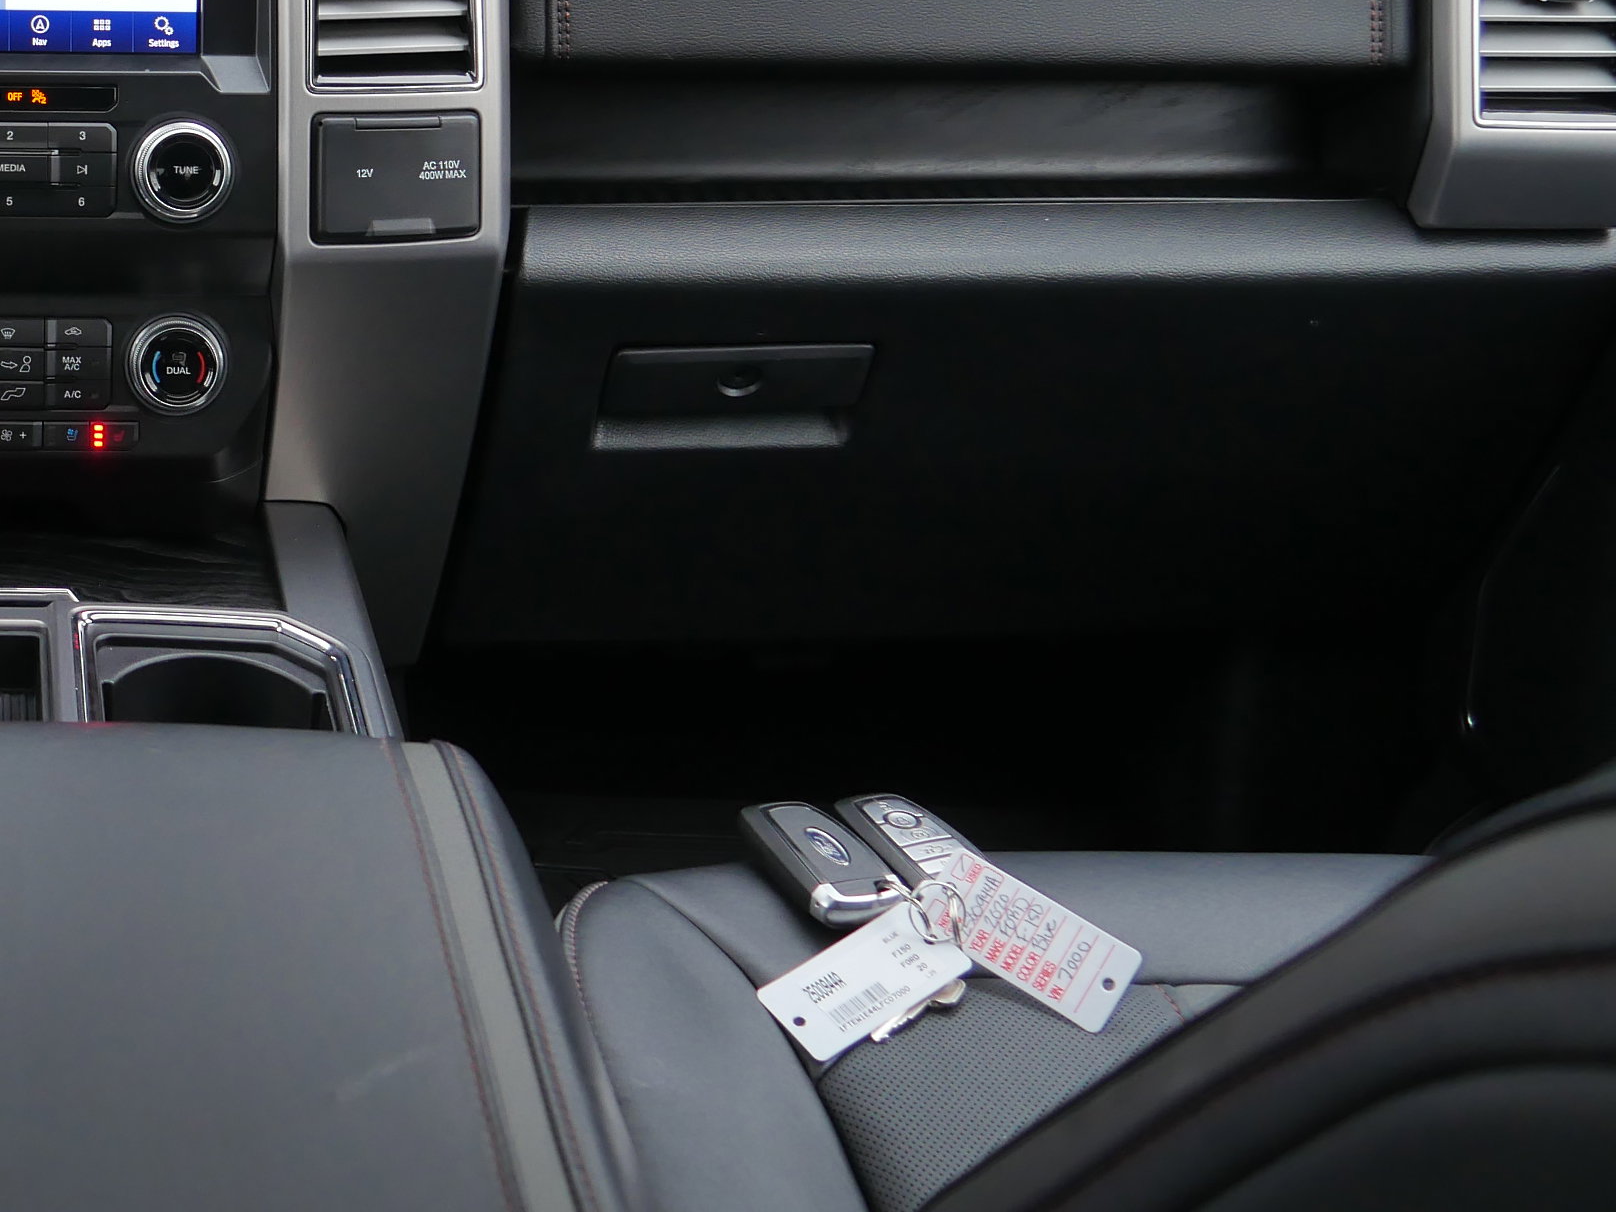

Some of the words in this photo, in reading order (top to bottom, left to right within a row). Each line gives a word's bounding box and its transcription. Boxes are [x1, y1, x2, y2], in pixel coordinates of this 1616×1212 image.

[32, 37, 48, 47] Nav
[92, 38, 112, 48] Apps
[148, 38, 180, 49] Settings
[7, 92, 23, 102] OFF
[6, 131, 14, 141] 2
[79, 131, 87, 141] 3
[423, 161, 437, 170] AC
[439, 160, 461, 170] 110V
[173, 165, 199, 176] TUNE
[356, 168, 374, 178] 12V
[419, 171, 444, 181] 400W
[445, 169, 467, 179] MAX
[6, 197, 13, 206] 5
[78, 197, 85, 207] 6
[62, 356, 82, 364] MAX
[166, 366, 192, 375] DUAL
[64, 390, 82, 399] A/C
[965, 863, 982, 884] USED
[999, 898, 1030, 937] FORD
[969, 929, 991, 953] YEAR
[986, 938, 1006, 963] MAKE
[900, 954, 920, 969] FORD
[1001, 944, 1025, 973] MODEL
[1058, 942, 1091, 980] 7000
[917, 962, 928, 972] 20
[1016, 952, 1041, 983] COLOR
[1032, 960, 1057, 992] SERIES
[1047, 984, 1065, 1001] VIN
